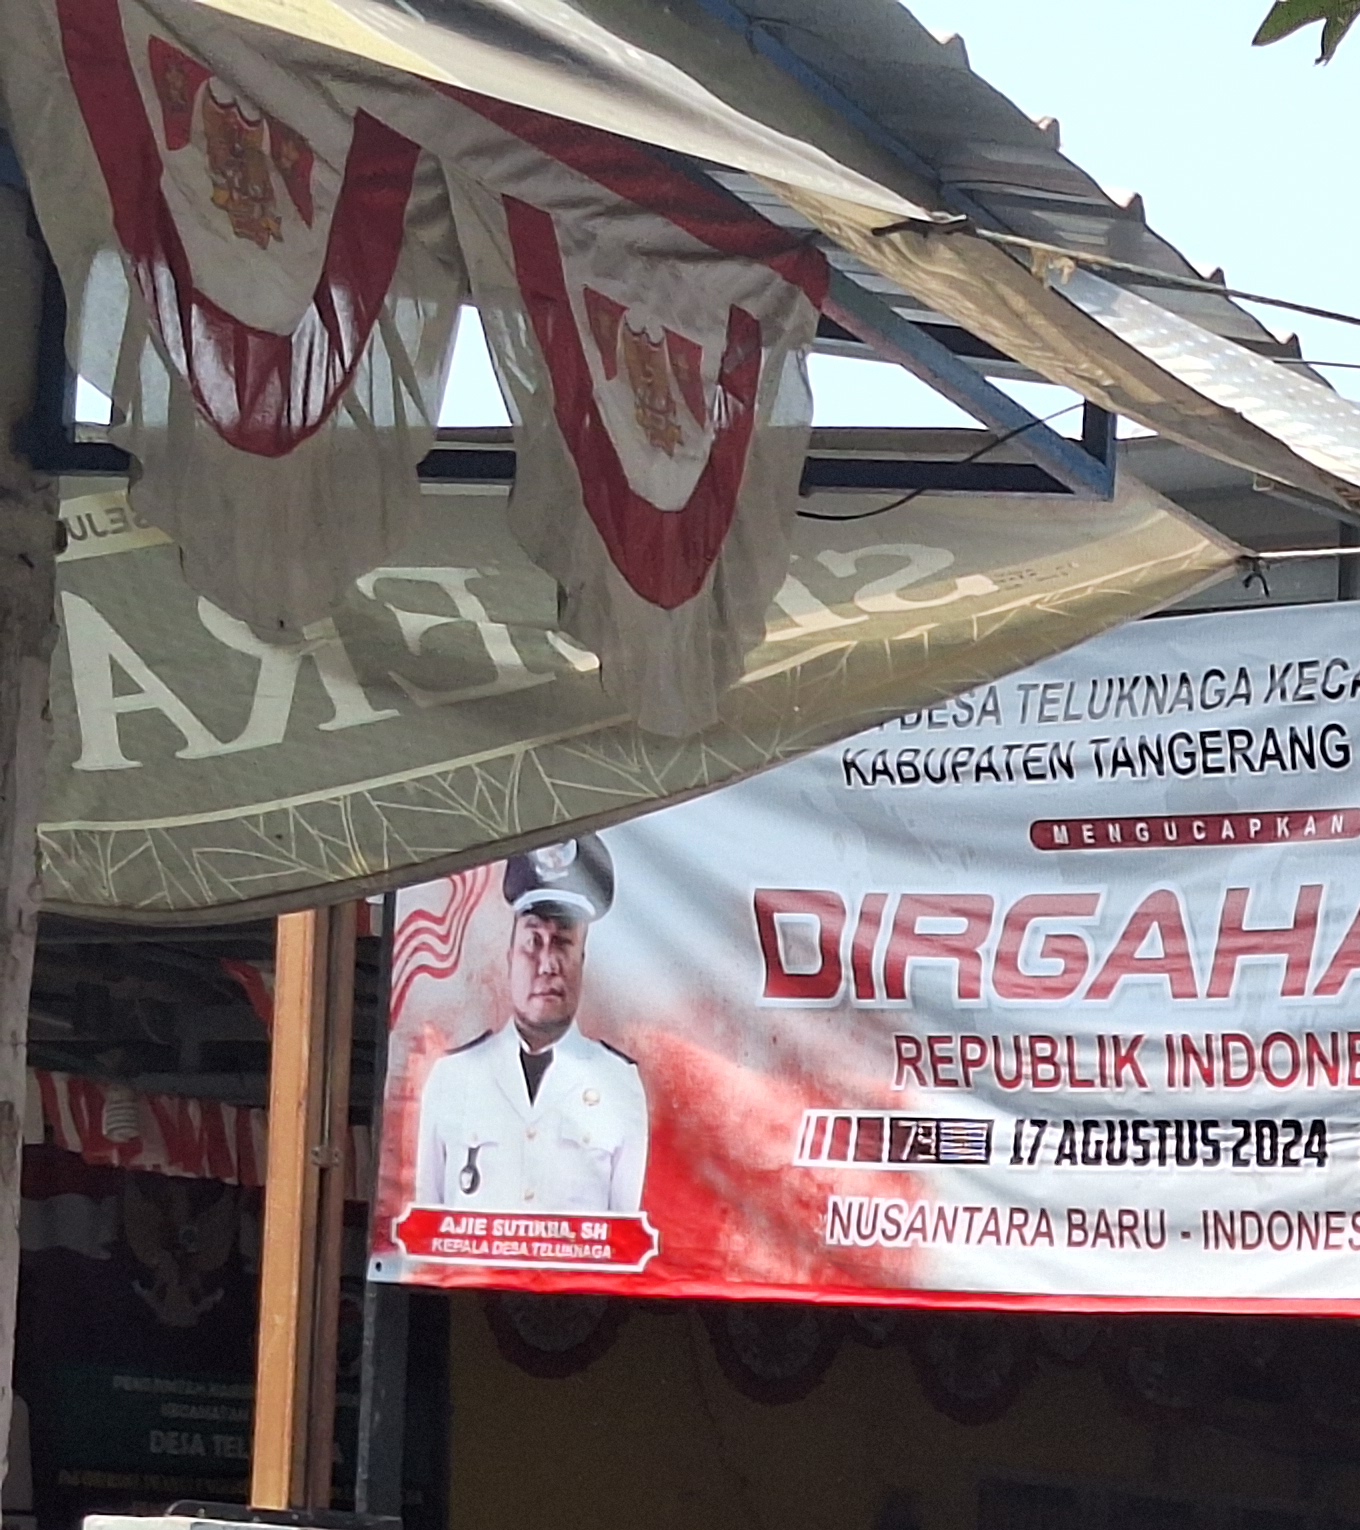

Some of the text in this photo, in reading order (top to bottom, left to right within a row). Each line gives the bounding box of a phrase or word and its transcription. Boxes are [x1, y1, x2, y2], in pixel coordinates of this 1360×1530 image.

[1016, 666, 1253, 725] TELUKNAGA
[841, 740, 1075, 787] KABUPATEN
[1090, 723, 1352, 779] TANGERANG
[1053, 812, 1345, 845] MENGUCAPKAN
[893, 1032, 1148, 1090] REPUBLIK
[1009, 1118, 1329, 1168] 17 AGUSTUS 2024
[431, 1236, 489, 1255] KEPALA
[439, 1216, 487, 1236] AJIE
[580, 1221, 609, 1241] SH
[825, 1199, 1056, 1247] NUSANTARA
[1066, 1208, 1167, 1249] BARU
